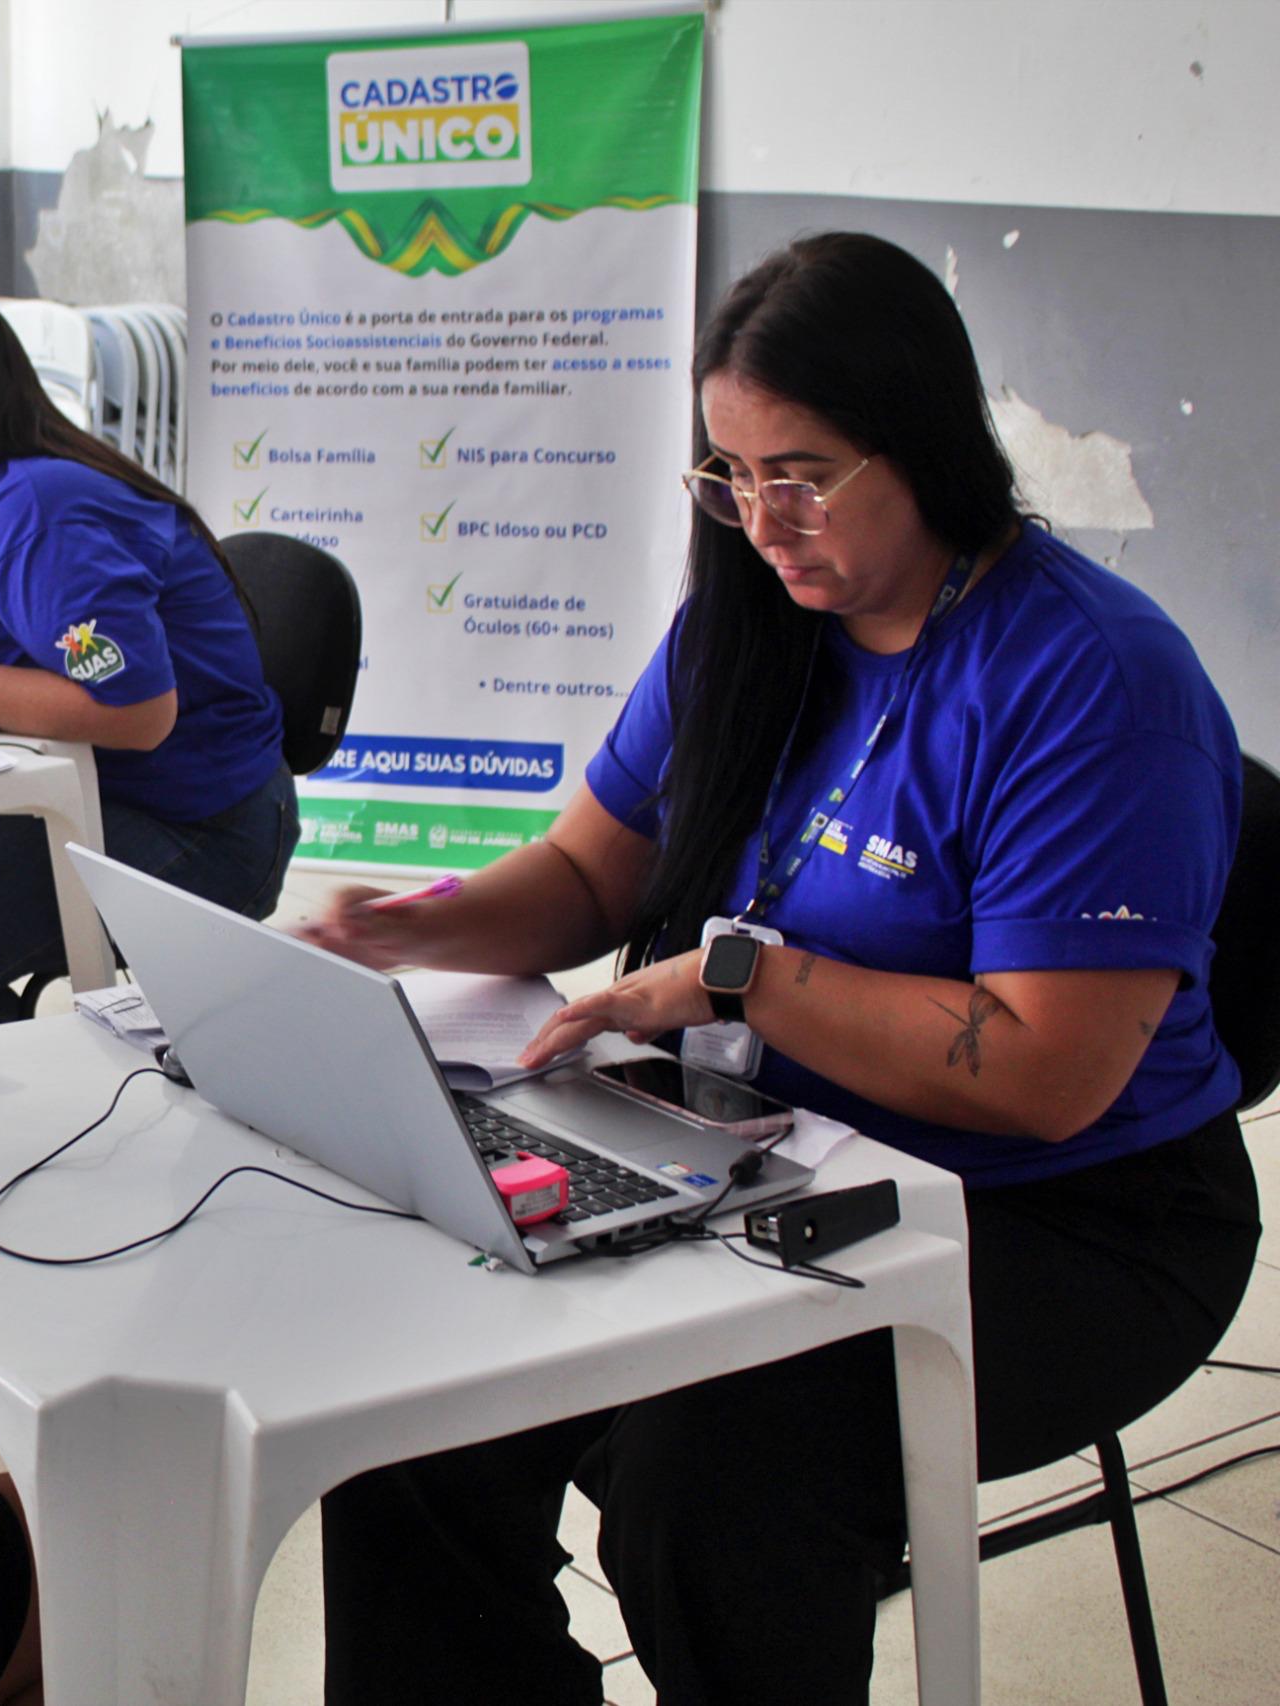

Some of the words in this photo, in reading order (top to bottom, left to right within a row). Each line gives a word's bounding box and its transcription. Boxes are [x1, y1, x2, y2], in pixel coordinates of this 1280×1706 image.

[340, 72, 519, 109] CADASTRO
[344, 113, 516, 164] ÚNICO
[211, 313, 223, 327] O
[228, 311, 295, 327] Cadastro
[300, 308, 341, 327] Único
[345, 311, 353, 325] é
[358, 313, 367, 325] a
[371, 311, 414, 328] porta
[418, 309, 436, 323] de
[441, 309, 503, 323] entrada
[508, 311, 545, 328] para
[550, 311, 568, 322] os
[573, 307, 664, 326] programas
[211, 338, 220, 350] e
[306, 333, 443, 349] Socioassistenciais
[447, 334, 466, 348] do
[470, 333, 538, 348] Governo
[543, 331, 609, 347] Federal.
[211, 359, 236, 373] Por
[242, 358, 279, 373] meio
[284, 358, 320, 375] dele,
[324, 357, 358, 372] você
[362, 361, 371, 372] e
[376, 360, 402, 372] sua
[406, 356, 460, 372] família
[465, 357, 520, 375] podem
[524, 357, 548, 371] ter
[552, 358, 608, 371] acesso
[612, 358, 622, 371] a
[626, 357, 671, 369] esses
[293, 382, 312, 396] de
[316, 382, 368, 396] acordo
[372, 384, 404, 396] com
[409, 384, 418, 396] a
[422, 384, 449, 396] sua
[453, 381, 500, 396] renda
[504, 381, 572, 396] familiar.
[268, 448, 312, 463] Bolsa
[317, 447, 376, 464] Família
[457, 447, 486, 463] NIS
[491, 451, 529, 467] para
[534, 448, 616, 464] Concurso
[270, 507, 364, 523] Carteirinha
[458, 521, 490, 537] BPC
[496, 522, 540, 538] Idoso
[545, 525, 567, 538] ou
[572, 523, 608, 539] PCD
[464, 593, 560, 611] Gratuidade
[564, 595, 587, 612] de
[464, 615, 521, 635] Óculos
[526, 620, 560, 639] (60+
[565, 623, 614, 640] anos)
[493, 678, 551, 693] Dentre
[361, 750, 410, 774] AQUI
[414, 751, 466, 773] SUAS
[470, 751, 554, 778] DÚVIDAS
[866, 834, 918, 868] SMAS
